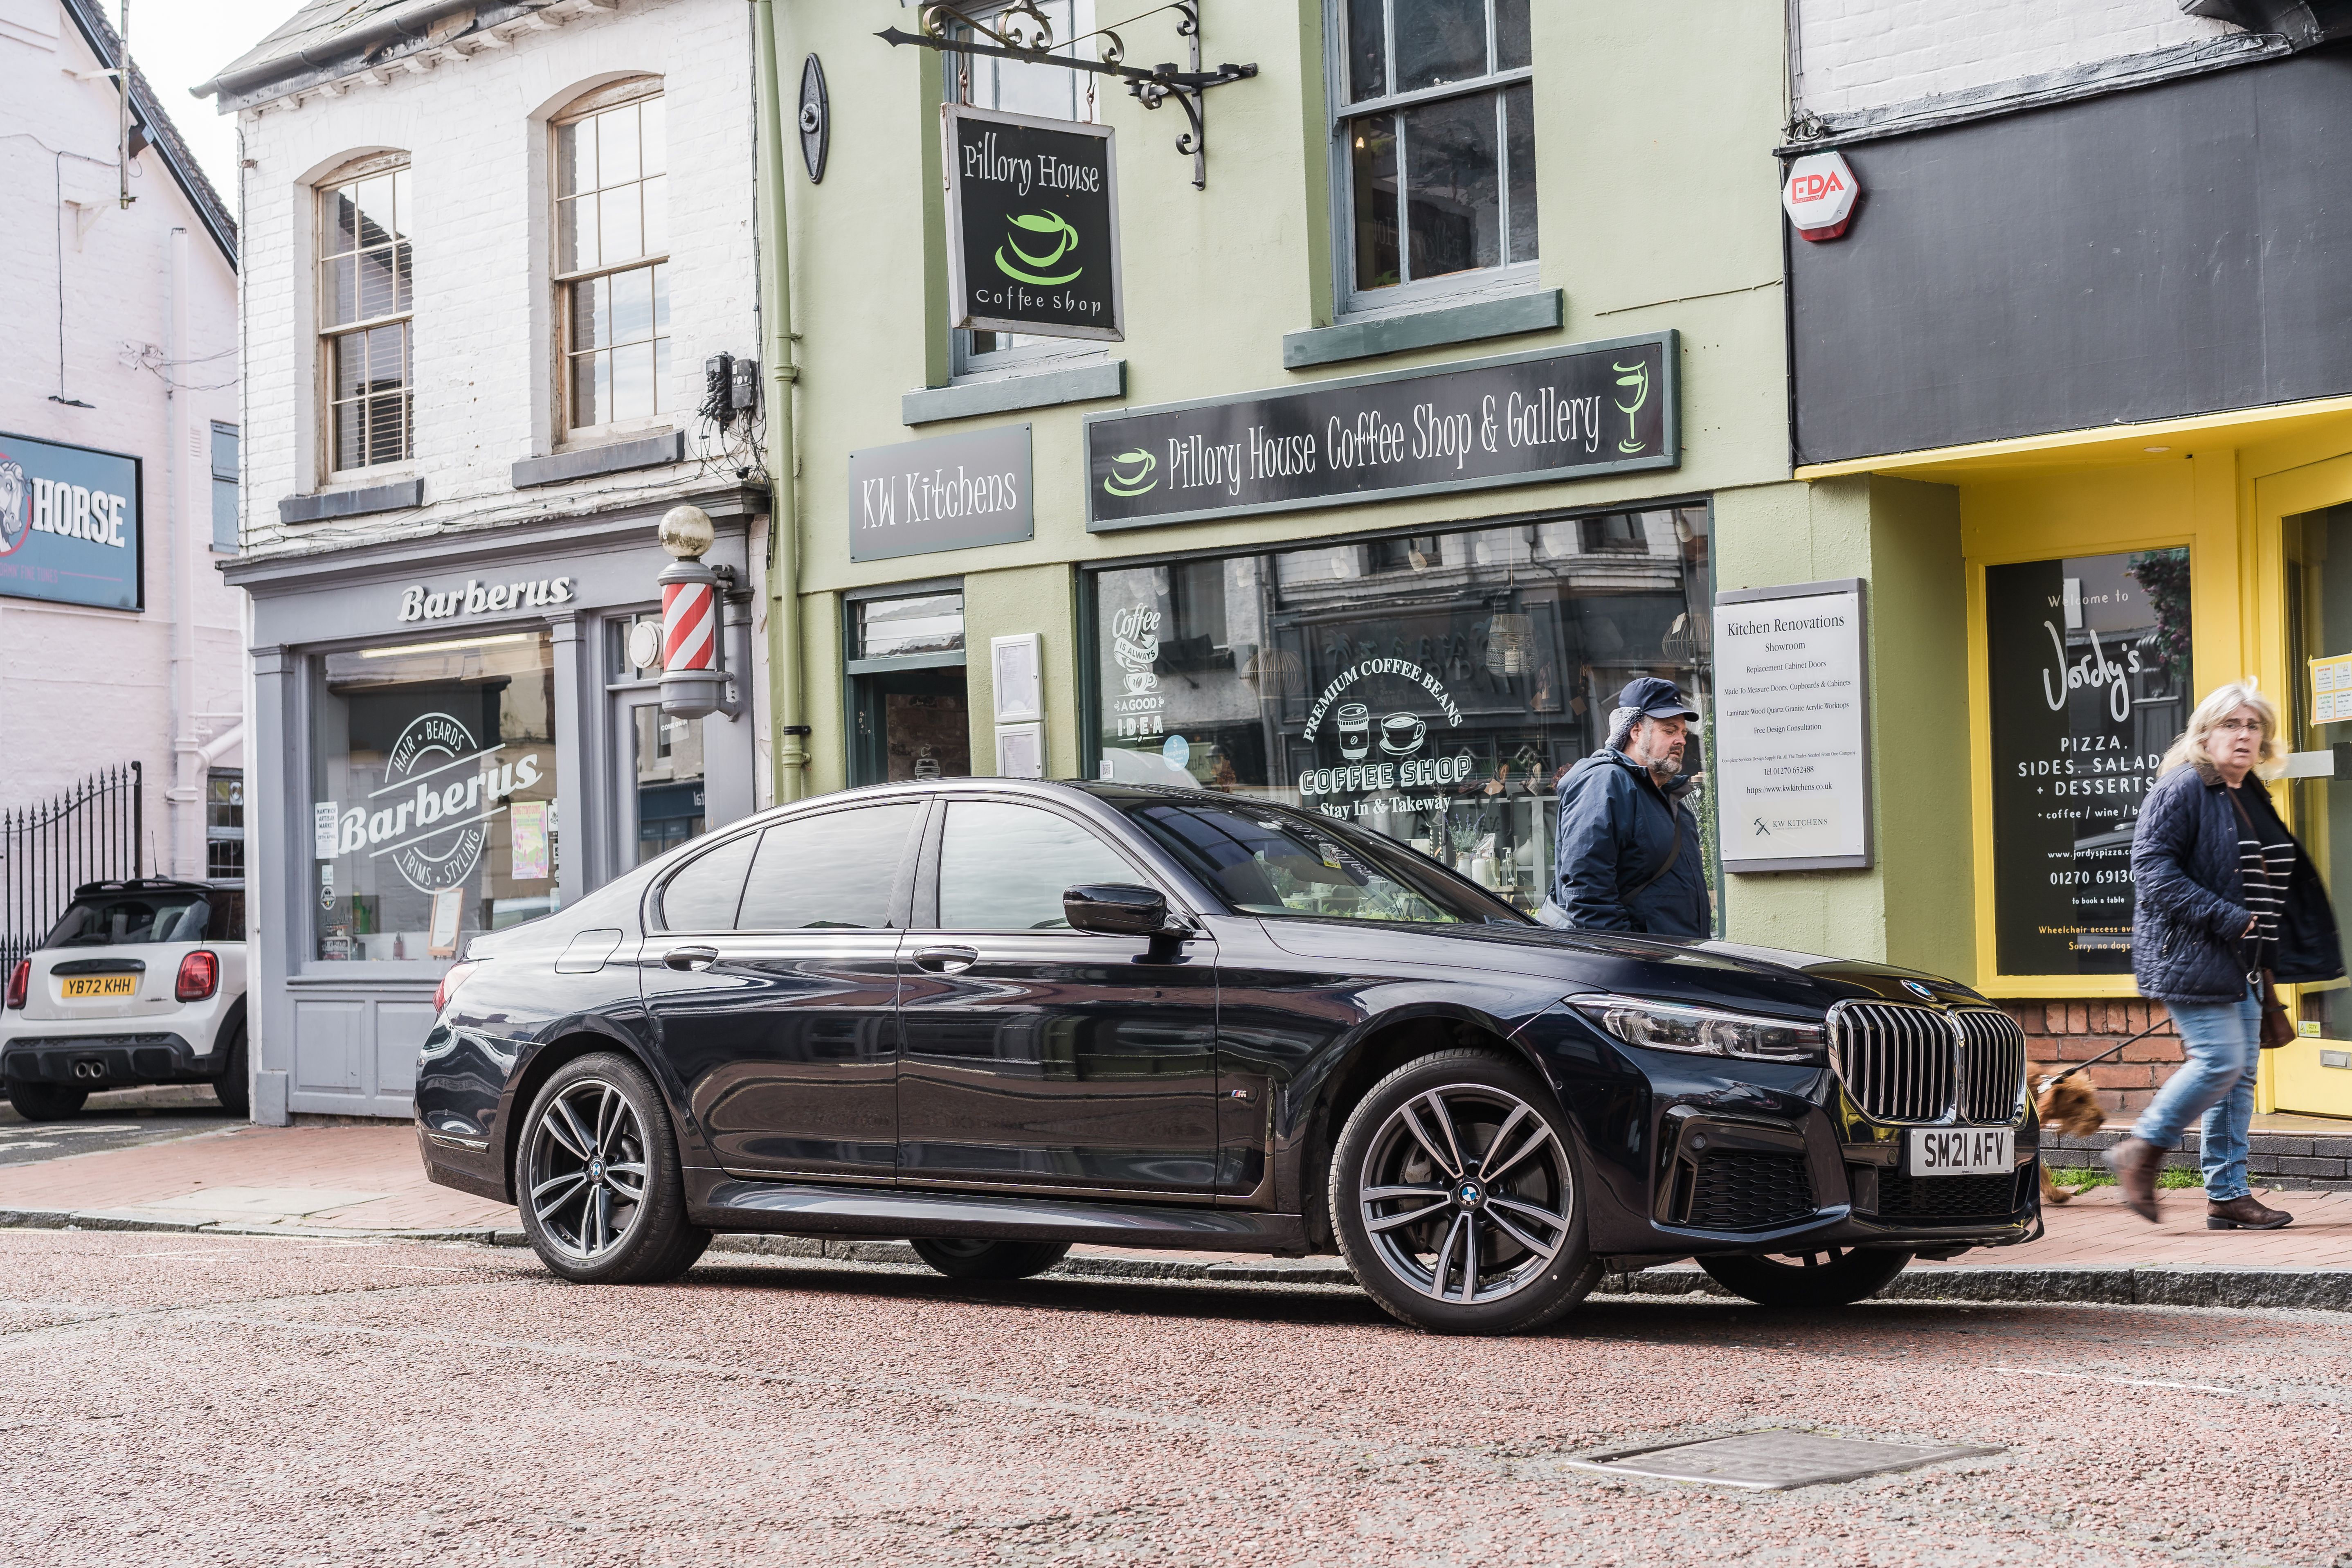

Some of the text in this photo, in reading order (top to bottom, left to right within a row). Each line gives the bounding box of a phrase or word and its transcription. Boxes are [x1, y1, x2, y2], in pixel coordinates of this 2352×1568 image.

[964, 132, 1100, 196] Pillory House
[1792, 171, 1844, 204] EDA
[976, 286, 1044, 310] Coffee
[1168, 387, 1601, 496] Pillory House Coffee Shop & Gallery
[862, 466, 1017, 529] KW Kitchens
[31, 477, 126, 549] HORSE
[20, 565, 35, 581] FINE
[37, 567, 58, 583] TUNES
[398, 576, 573, 622] Barberus
[2048, 589, 2129, 607] Welcome to
[1112, 603, 1161, 641] Coffee
[1727, 614, 1844, 637] Kitchen Renovations
[1120, 641, 1156, 661] IS ALWAYS
[1765, 641, 1806, 652] Showroom
[1746, 660, 1826, 674] Replacement Cabinet Doors
[2043, 621, 2140, 722] Jordy's
[1790, 681, 1819, 691] Cupboards
[1827, 679, 1851, 688] Cabinets
[1120, 697, 1157, 711] A GOOD
[1303, 666, 1360, 743] PREMIUM
[1360, 658, 1422, 682] COFFEE
[1421, 672, 1463, 728] BEANS
[1766, 707, 1784, 715] Quartz
[1785, 704, 1804, 713] Granite
[1806, 704, 1823, 712] Acrylic
[1824, 702, 1849, 710] Worktops
[661, 722, 675, 731] COME
[1767, 726, 1785, 734] Design
[1786, 723, 1821, 732] Consultation
[394, 721, 464, 772] HAIR BEARDS
[1173, 739, 1178, 747] S
[1164, 748, 1189, 757] Snugburys
[1299, 756, 1472, 796] COFFEE SHOP
[1773, 767, 1791, 775] 01270
[1792, 765, 1814, 774] 652488
[1747, 782, 1833, 795] https://www.kwkitchens.co.uk
[2055, 777, 2155, 796] DESSERTS
[338, 754, 543, 855] Barberus
[1320, 796, 1451, 821] Stay In & Takeway
[2046, 809, 2081, 819] coffee
[2094, 808, 2119, 817] wine
[1788, 818, 1828, 827] KITCHENS
[402, 829, 479, 886] TRIMS STYLING
[2050, 871, 2090, 885] 01270
[2038, 926, 2087, 934] Wheelchair
[2111, 941, 2131, 952] dogs
[69, 978, 131, 994] YB72 KHH
[1924, 1132, 2004, 1168] SM21 AFV
